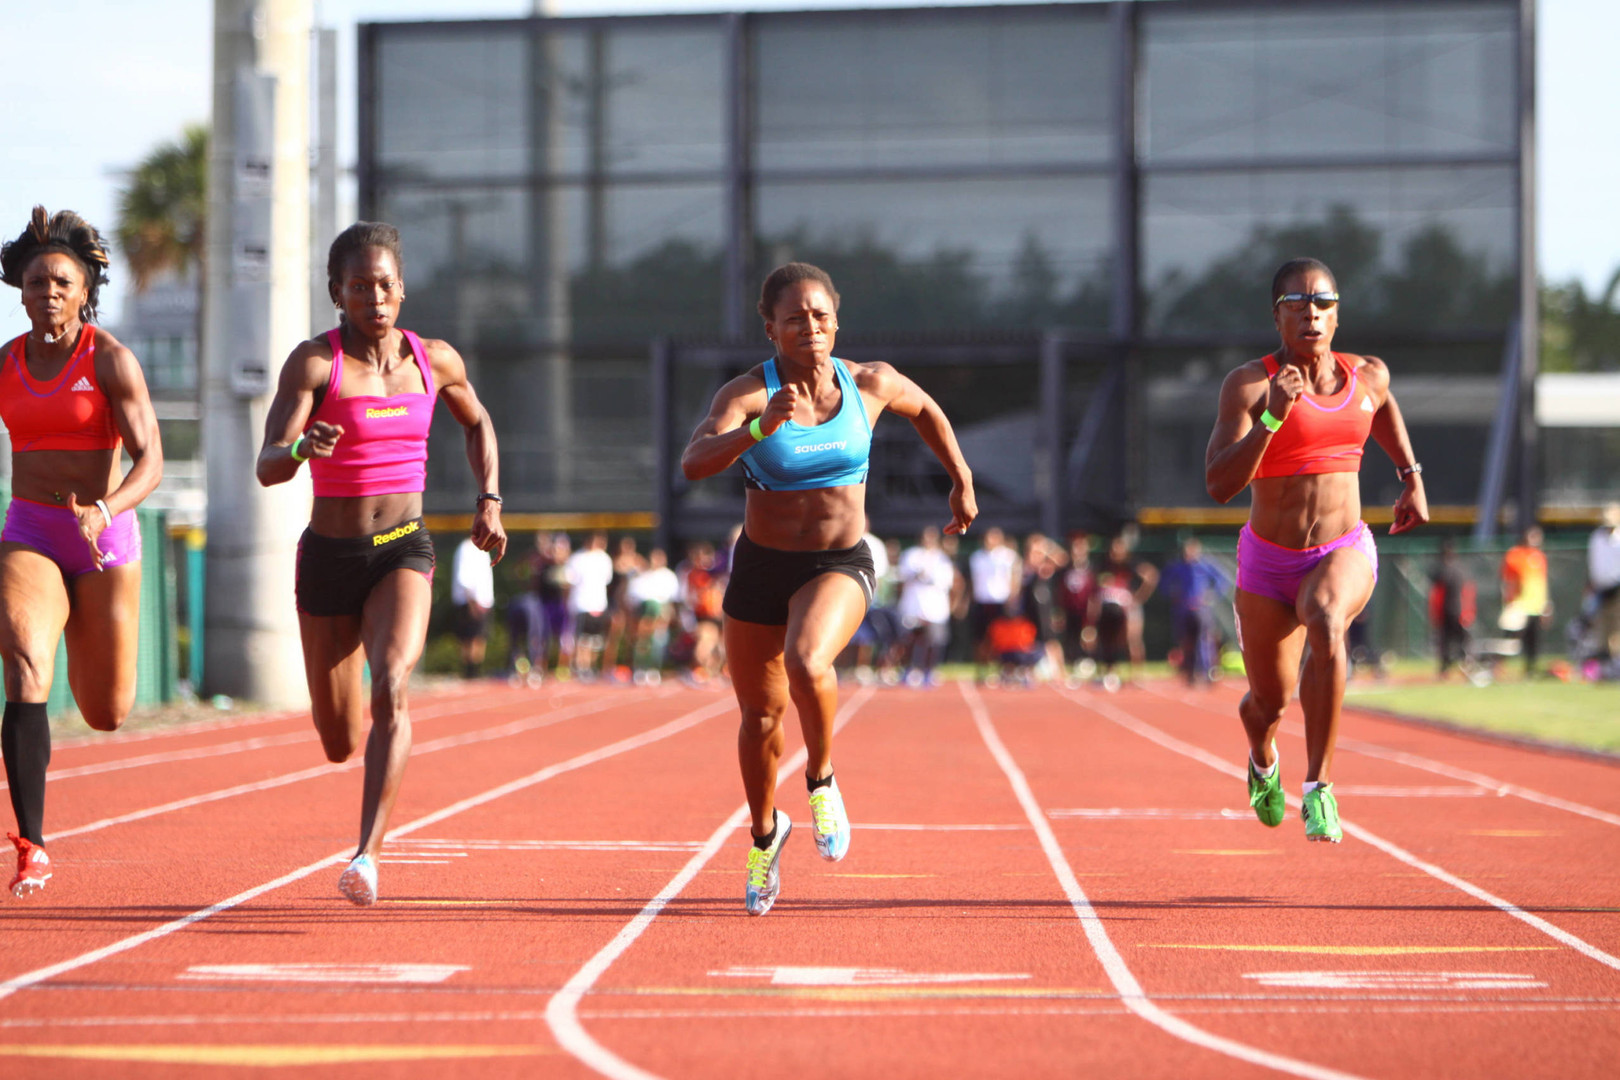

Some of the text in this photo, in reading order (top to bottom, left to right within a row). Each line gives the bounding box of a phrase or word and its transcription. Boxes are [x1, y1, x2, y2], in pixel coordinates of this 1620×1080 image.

[366, 406, 408, 419] Reebok
[794, 440, 847, 454] saucony
[373, 522, 420, 546] Reebok
